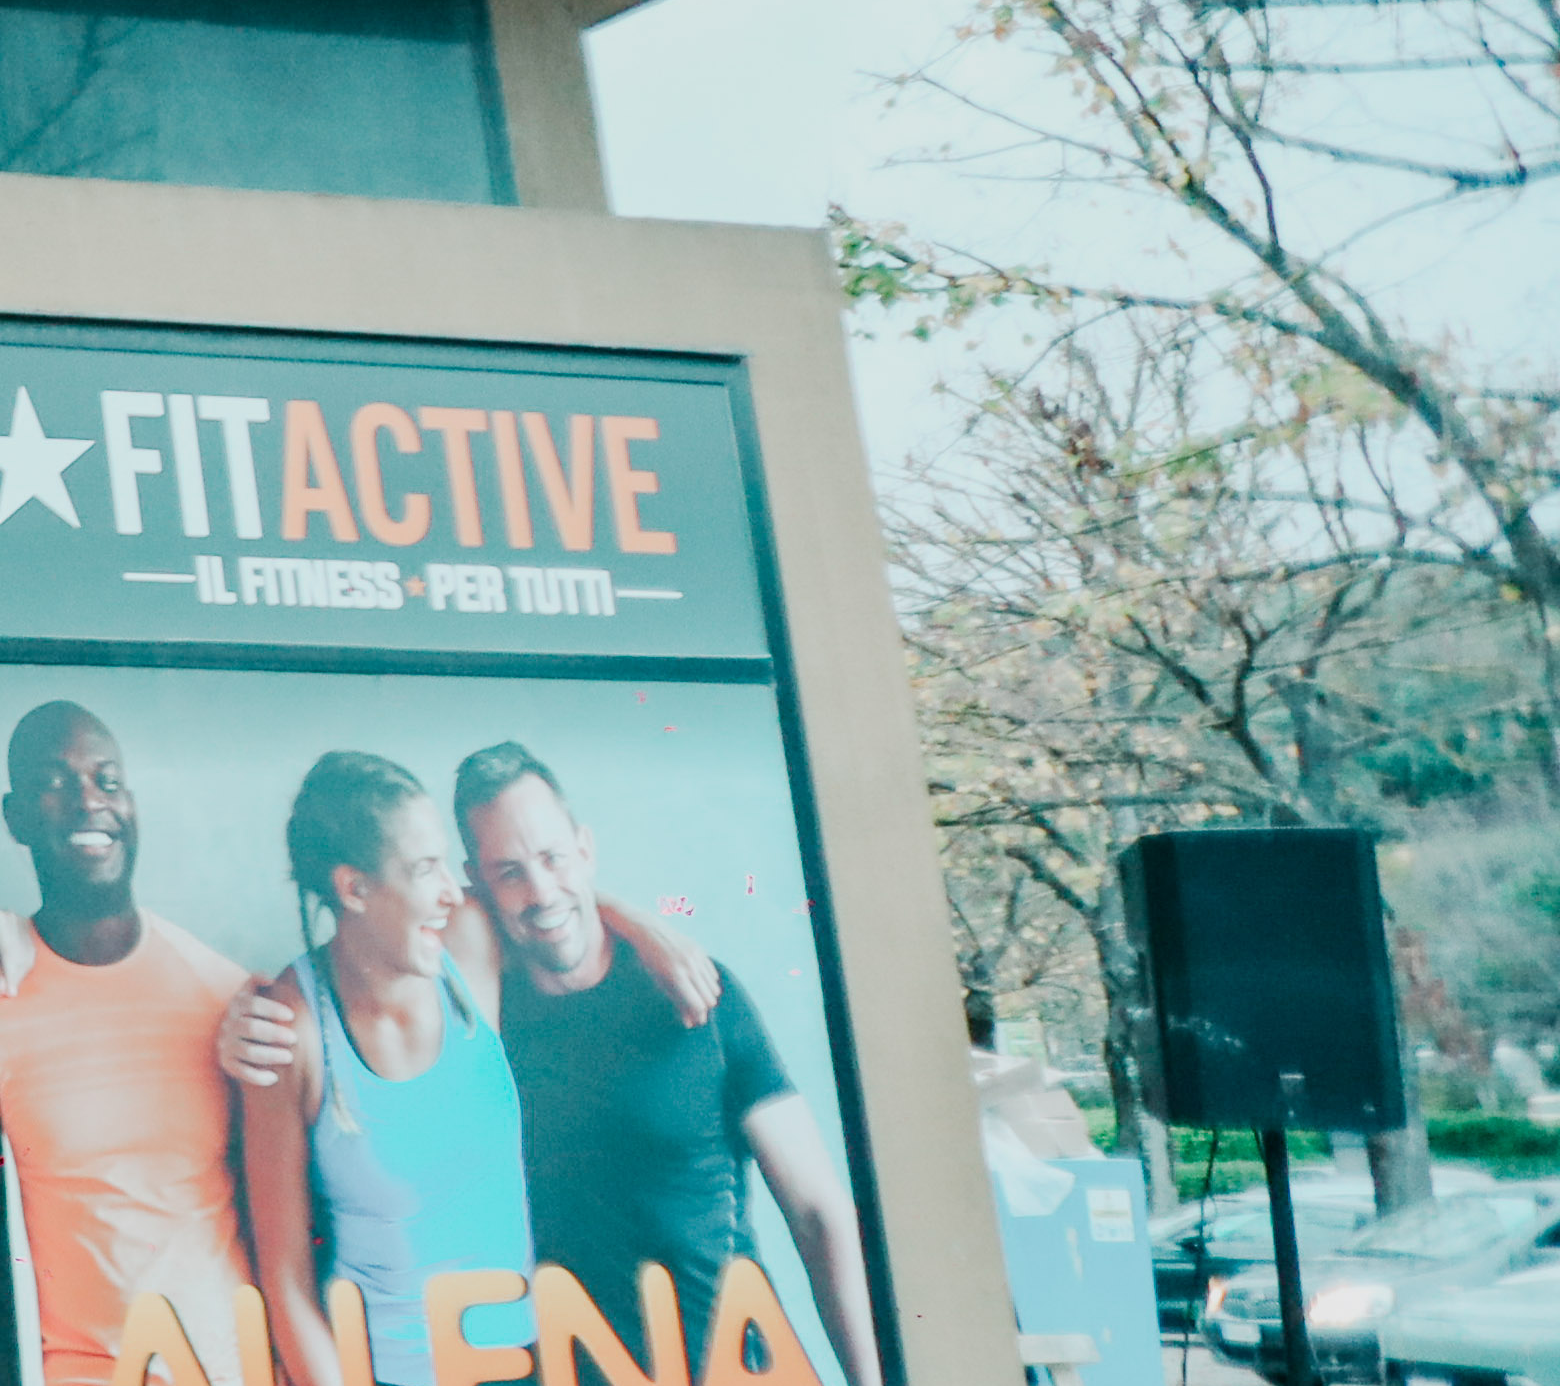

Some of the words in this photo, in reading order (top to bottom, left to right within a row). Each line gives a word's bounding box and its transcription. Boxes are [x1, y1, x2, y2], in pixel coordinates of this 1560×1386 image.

[100, 388, 678, 554] FITACTIVE
[194, 554, 237, 605] IL
[237, 555, 404, 611] FITNESS
[425, 562, 508, 614] PER
[507, 566, 617, 617] TUTTI
